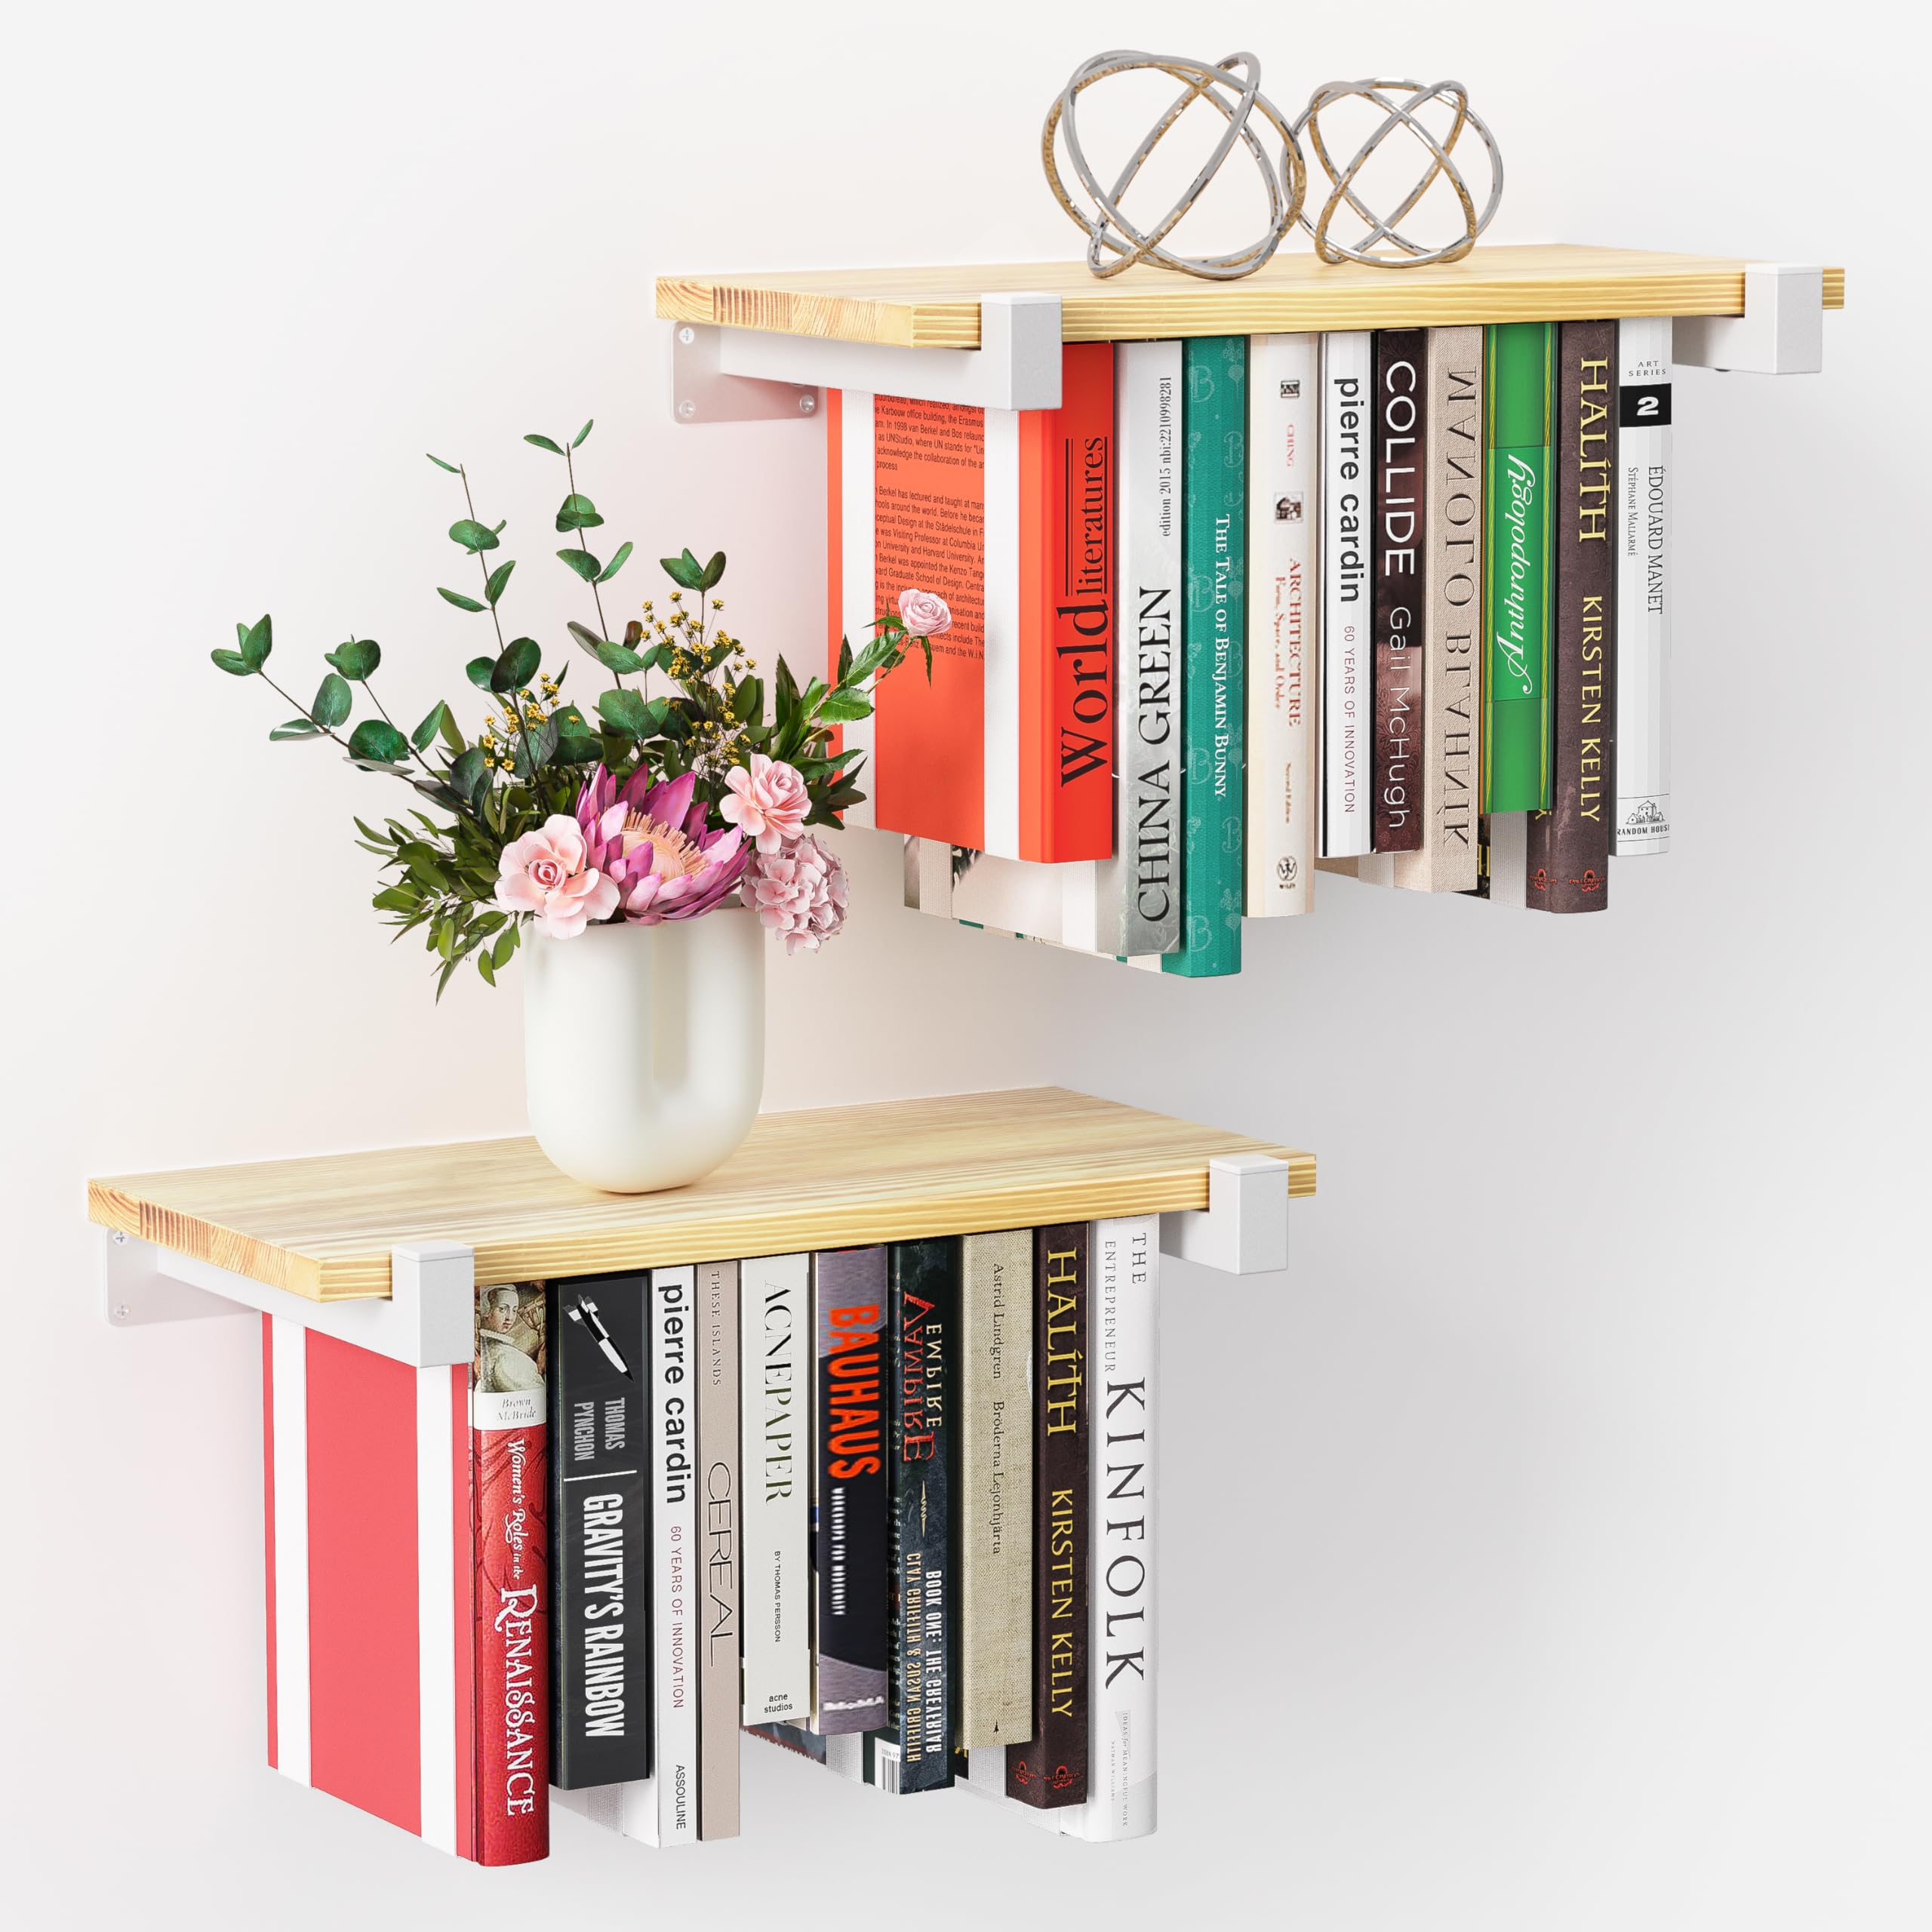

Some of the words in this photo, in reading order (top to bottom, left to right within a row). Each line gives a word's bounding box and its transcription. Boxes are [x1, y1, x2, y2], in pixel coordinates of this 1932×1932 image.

[1629, 368, 1666, 377] SERIES
[907, 409, 922, 419] office
[949, 414, 957, 424] the
[959, 415, 984, 428] Erasmus
[921, 424, 938, 435] Berkel
[940, 428, 949, 437] and
[952, 429, 962, 438] Bos
[1334, 378, 1364, 480] pierre
[1637, 396, 1660, 416] 2
[877, 447, 912, 460] acknowledge
[914, 451, 922, 460] the
[924, 453, 959, 466] collaboration
[968, 457, 977, 468] the
[877, 461, 897, 470] process
[915, 438, 932, 448] where
[934, 439, 943, 449] UN
[944, 441, 962, 452] stands
[1385, 361, 1417, 576] COLLIDE
[879, 485, 896, 497] Berkel
[898, 488, 908, 499] has
[909, 491, 931, 502] lectured
[933, 495, 943, 504] and
[945, 496, 962, 508] taught
[1158, 468, 1171, 494] 2015
[1648, 465, 1666, 551] ÉDOUARD
[891, 502, 910, 512] around
[912, 504, 920, 513] the
[922, 507, 939, 516] world.
[940, 508, 958, 519] Before
[898, 515, 916, 528] Design
[925, 520, 934, 530] the
[1075, 437, 1103, 595] literatures
[1158, 498, 1171, 537] edition
[1215, 514, 1229, 552] THE
[879, 553, 896, 564] Berkel
[911, 560, 937, 571] appointed
[939, 563, 948, 573] the
[949, 564, 968, 576] Kenzo
[882, 540, 909, 555] University
[911, 546, 921, 555] and
[923, 546, 945, 558] Harvard
[946, 550, 976, 565] University.
[893, 528, 913, 542] Visiting
[915, 531, 940, 544] Professor
[949, 537, 976, 550] Columbia
[1340, 494, 1364, 602] cardin
[888, 568, 914, 580] Graduate
[915, 571, 934, 584] School
[943, 577, 964, 589] Design.
[1215, 557, 1229, 605] TALE
[1496, 454, 1537, 694] Anthropology
[1648, 555, 1663, 614] MANET
[952, 620, 970, 630] recent
[953, 634, 973, 645] include
[1214, 608, 1227, 632] OF
[1289, 558, 1303, 726] ARCHITECTURE
[1344, 626, 1355, 641] 60
[1389, 607, 1412, 670] Gail
[1138, 586, 1172, 746] GREEN
[1212, 637, 1229, 729] BENJAMIN
[1344, 647, 1355, 694] YEARS
[1581, 595, 1603, 724] KIRSTEN
[1056, 599, 1109, 788] World
[1344, 700, 1355, 718] OF
[1214, 734, 1229, 798] BUNNY
[1344, 724, 1355, 813] INNOVATION
[1383, 687, 1411, 828] McHugh
[1580, 737, 1601, 822] KELLY
[1137, 759, 1171, 922] CHINA
[993, 1263, 1004, 1307] Astrid
[1132, 1232, 1146, 1284] THE
[711, 1271, 721, 1319] THESE
[1104, 1241, 1116, 1372] ENTREPRENEUR
[658, 1284, 689, 1385] pierre
[712, 1324, 721, 1386] ISLANDS
[989, 1311, 1004, 1379] Lindgren
[764, 1280, 793, 1505] ACNEPAPER
[827, 1303, 881, 1479] BAUHAUS
[574, 1401, 595, 1462] PYNCHON
[605, 1397, 625, 1451] THOMAS
[665, 1397, 691, 1504] cardin
[505, 1508, 529, 1551] Roles
[583, 1494, 625, 1620] GRAVITY'S
[670, 1526, 681, 1542] 60
[774, 1550, 782, 1562] BY
[1051, 1489, 1073, 1619] KIRSTEN
[1106, 1377, 1146, 1690] KINFOLK
[671, 1547, 682, 1592] YEARS
[707, 1461, 734, 1667] CEREAL
[671, 1598, 683, 1616] OF
[584, 1623, 625, 1737] RAINBOW
[672, 1623, 685, 1709] INNOVATION
[1051, 1632, 1072, 1718] KELLY
[494, 1583, 538, 1817] RENAISSANCE
[764, 1702, 793, 1714] studios
[768, 1693, 789, 1703] acne
[675, 1764, 686, 1830] ASSOULINE
